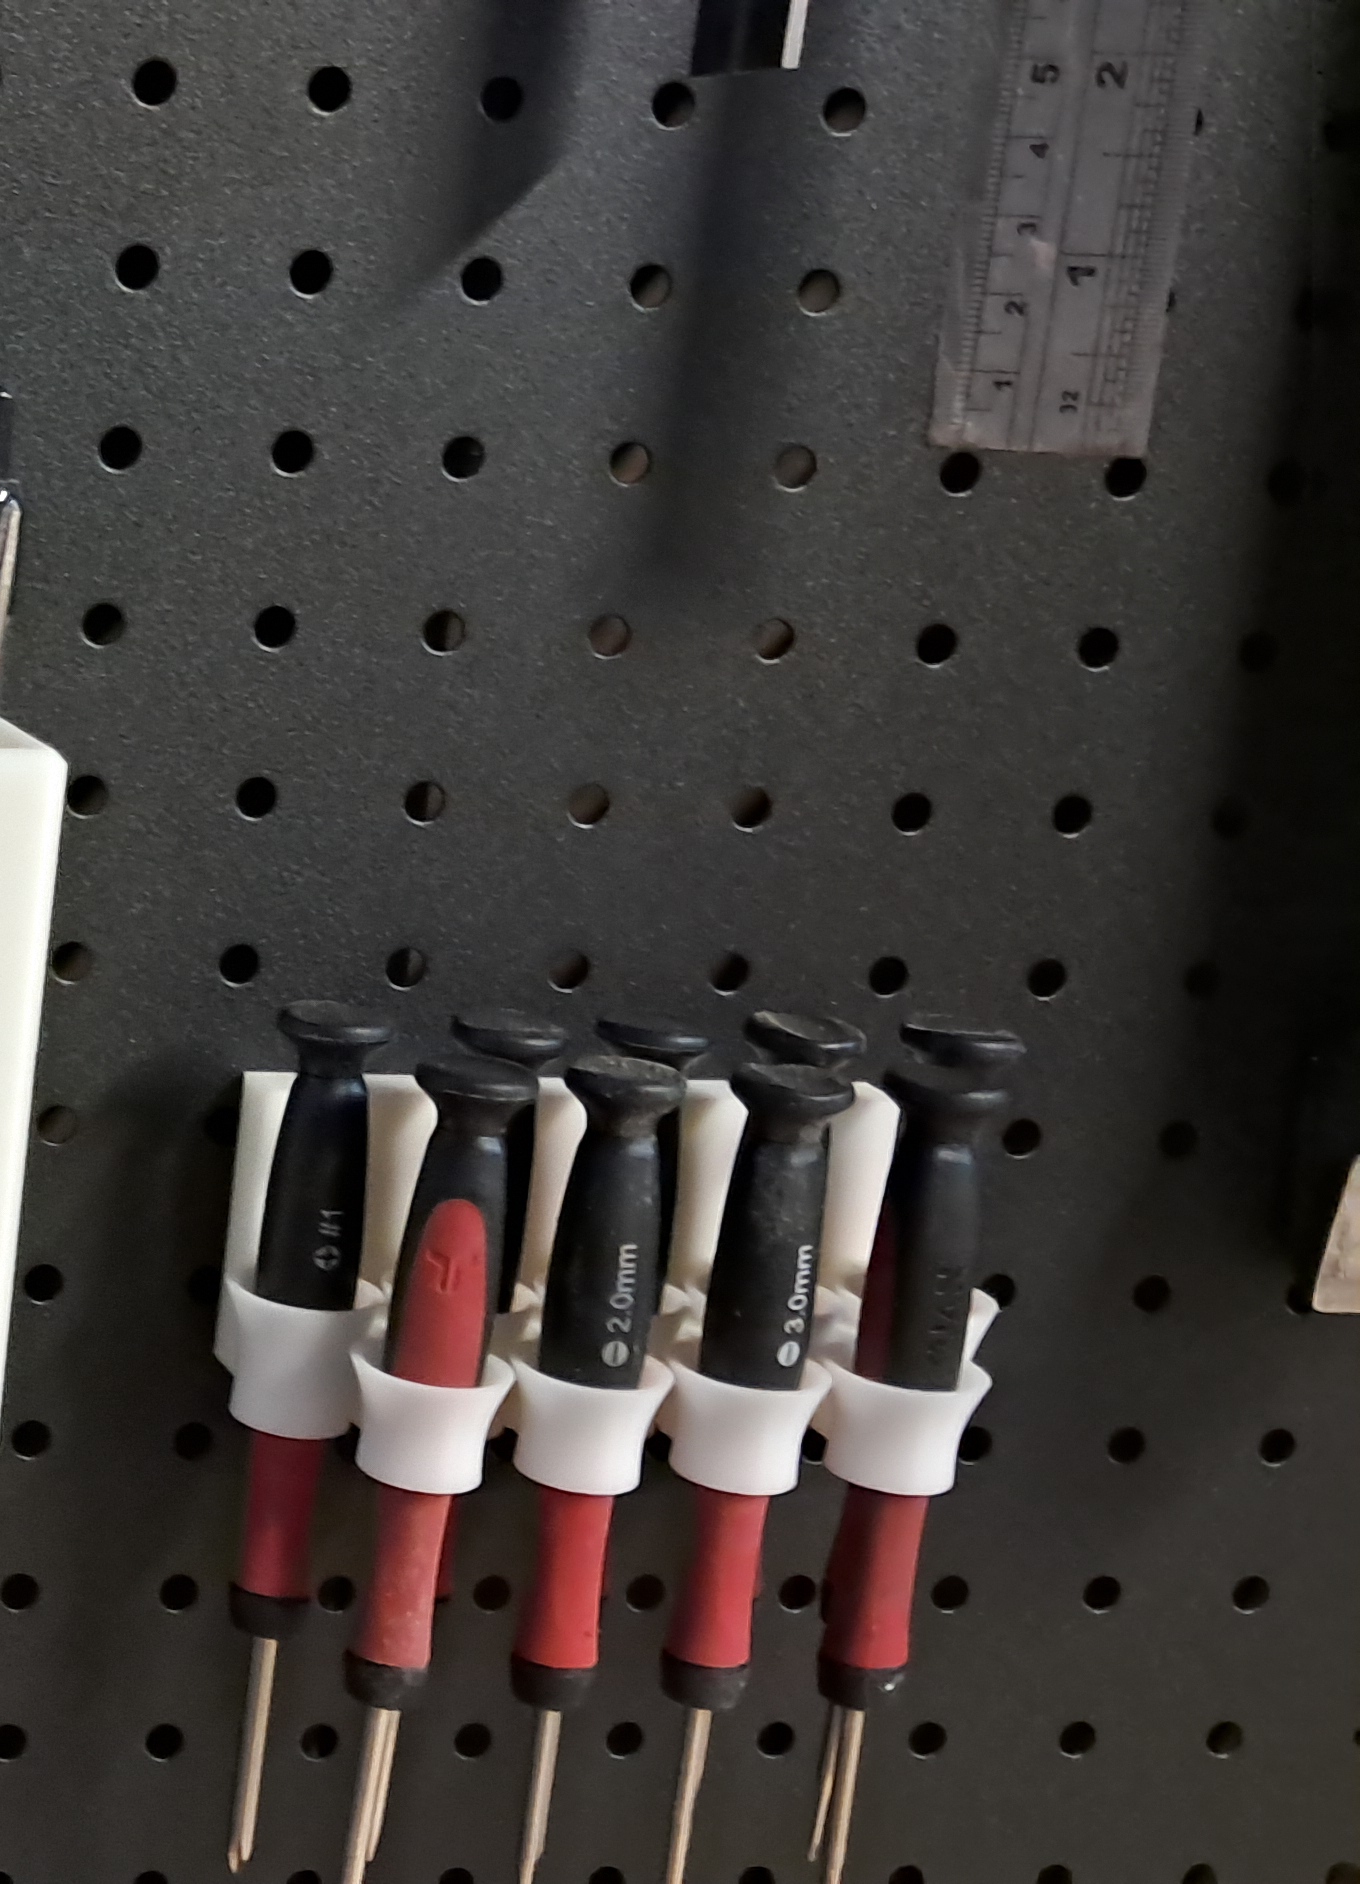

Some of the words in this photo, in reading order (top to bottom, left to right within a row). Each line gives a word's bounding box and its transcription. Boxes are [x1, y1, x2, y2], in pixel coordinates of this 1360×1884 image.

[1031, 63, 1060, 84] 5
[1095, 60, 1128, 90] 2
[1066, 264, 1096, 287] 1
[1004, 300, 1027, 317] 2
[606, 1244, 638, 1333] 2.0mm
[783, 1245, 813, 1334] 3.0mm
